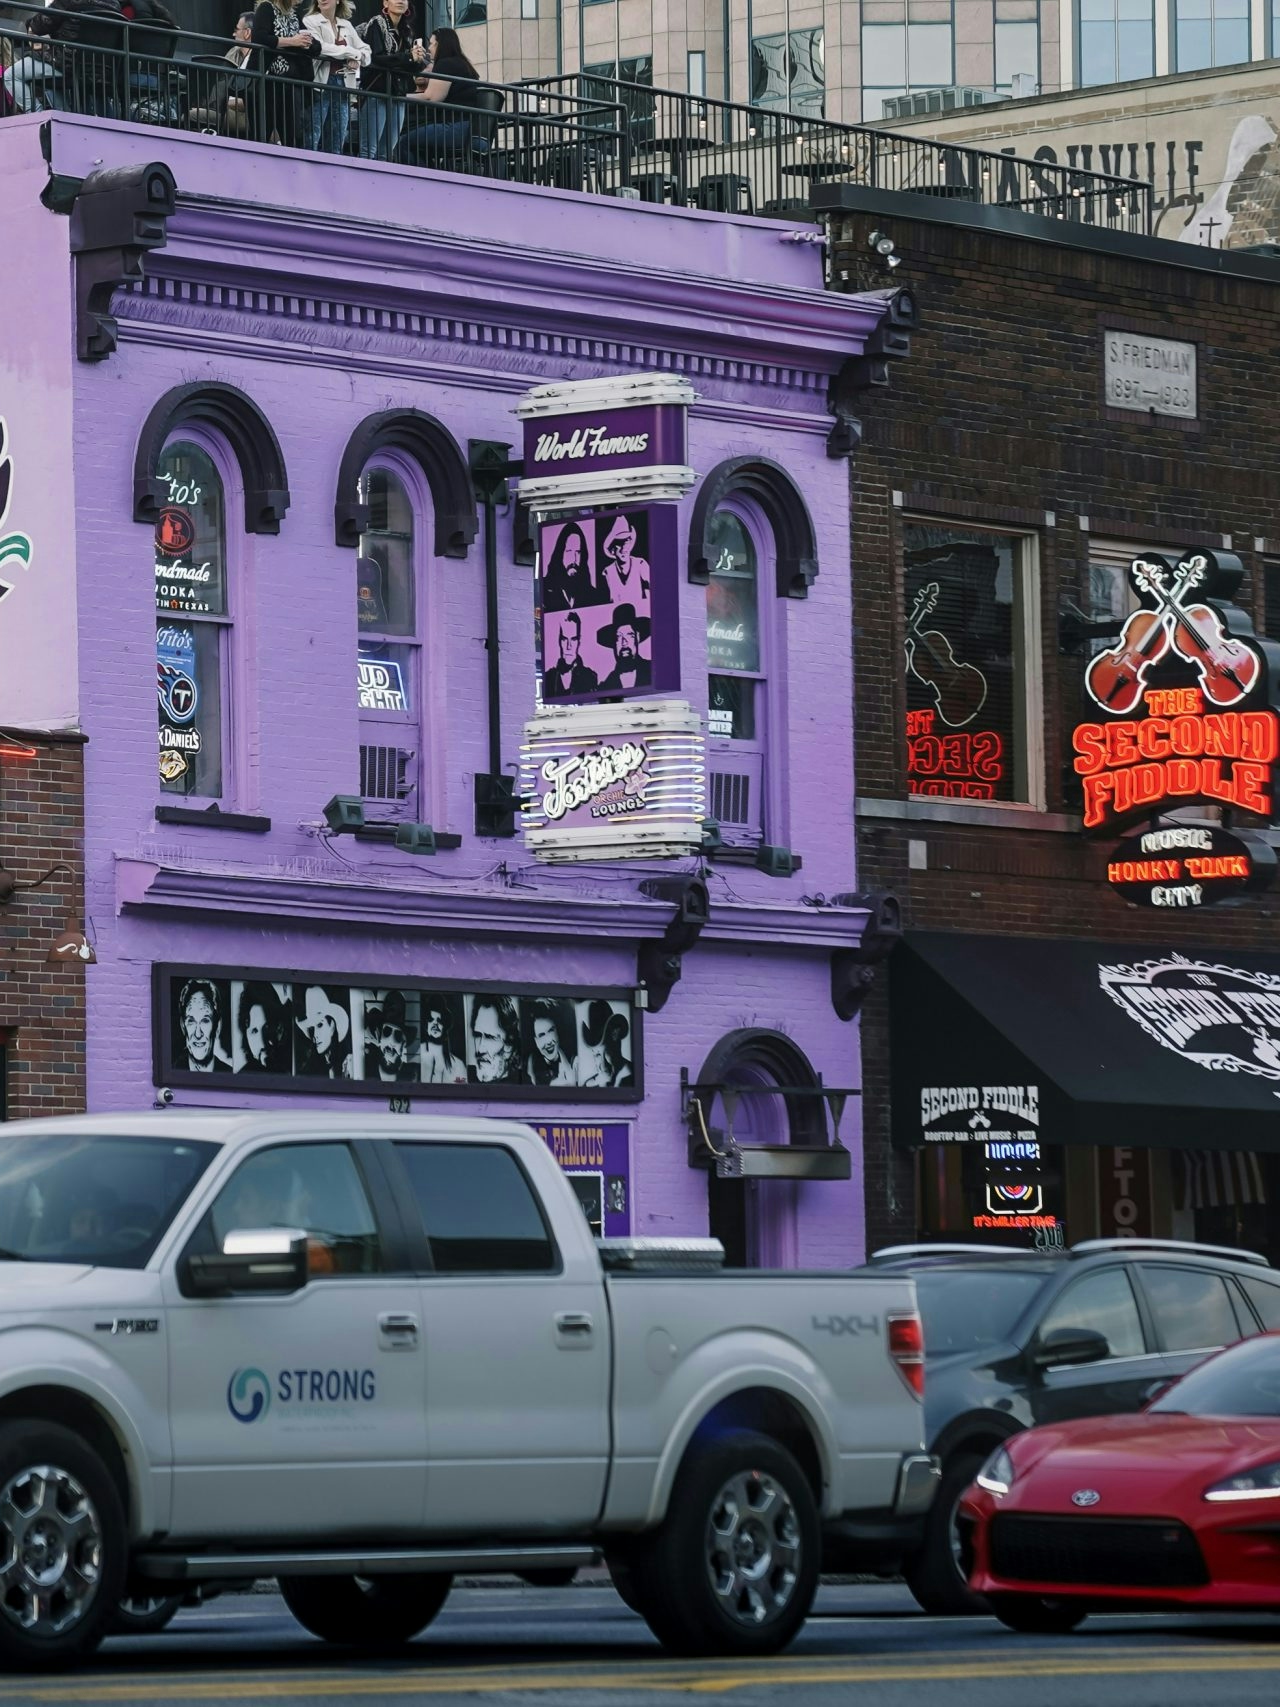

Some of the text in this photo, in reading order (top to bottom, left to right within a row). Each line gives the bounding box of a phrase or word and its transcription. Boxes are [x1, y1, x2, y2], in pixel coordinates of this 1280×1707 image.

[534, 426, 649, 462] World Famous
[179, 601, 209, 611] TEXAS
[159, 629, 193, 650] Tito's
[358, 664, 390, 688] UD
[358, 687, 402, 711] GHT
[1143, 688, 1204, 717] THE
[164, 728, 200, 750] DANIEL'S
[1072, 711, 1279, 775] SECOND
[542, 742, 648, 820] Tootsies
[1083, 759, 1272, 828] FIDDLE
[591, 797, 646, 818] LOUNGE
[1141, 828, 1213, 853] MUSIC
[1108, 855, 1250, 882] HONKY TONK
[1151, 883, 1203, 907] CITY
[1186, 973, 1217, 987] THE
[1120, 985, 1243, 1049] SECOND
[921, 1086, 1040, 1126] SECOND FIDDLE
[552, 1127, 604, 1166] FAMOUS
[973, 1215, 991, 1228] IT'S
[991, 1215, 1029, 1228] MILLER
[278, 1369, 376, 1402] STRONG
